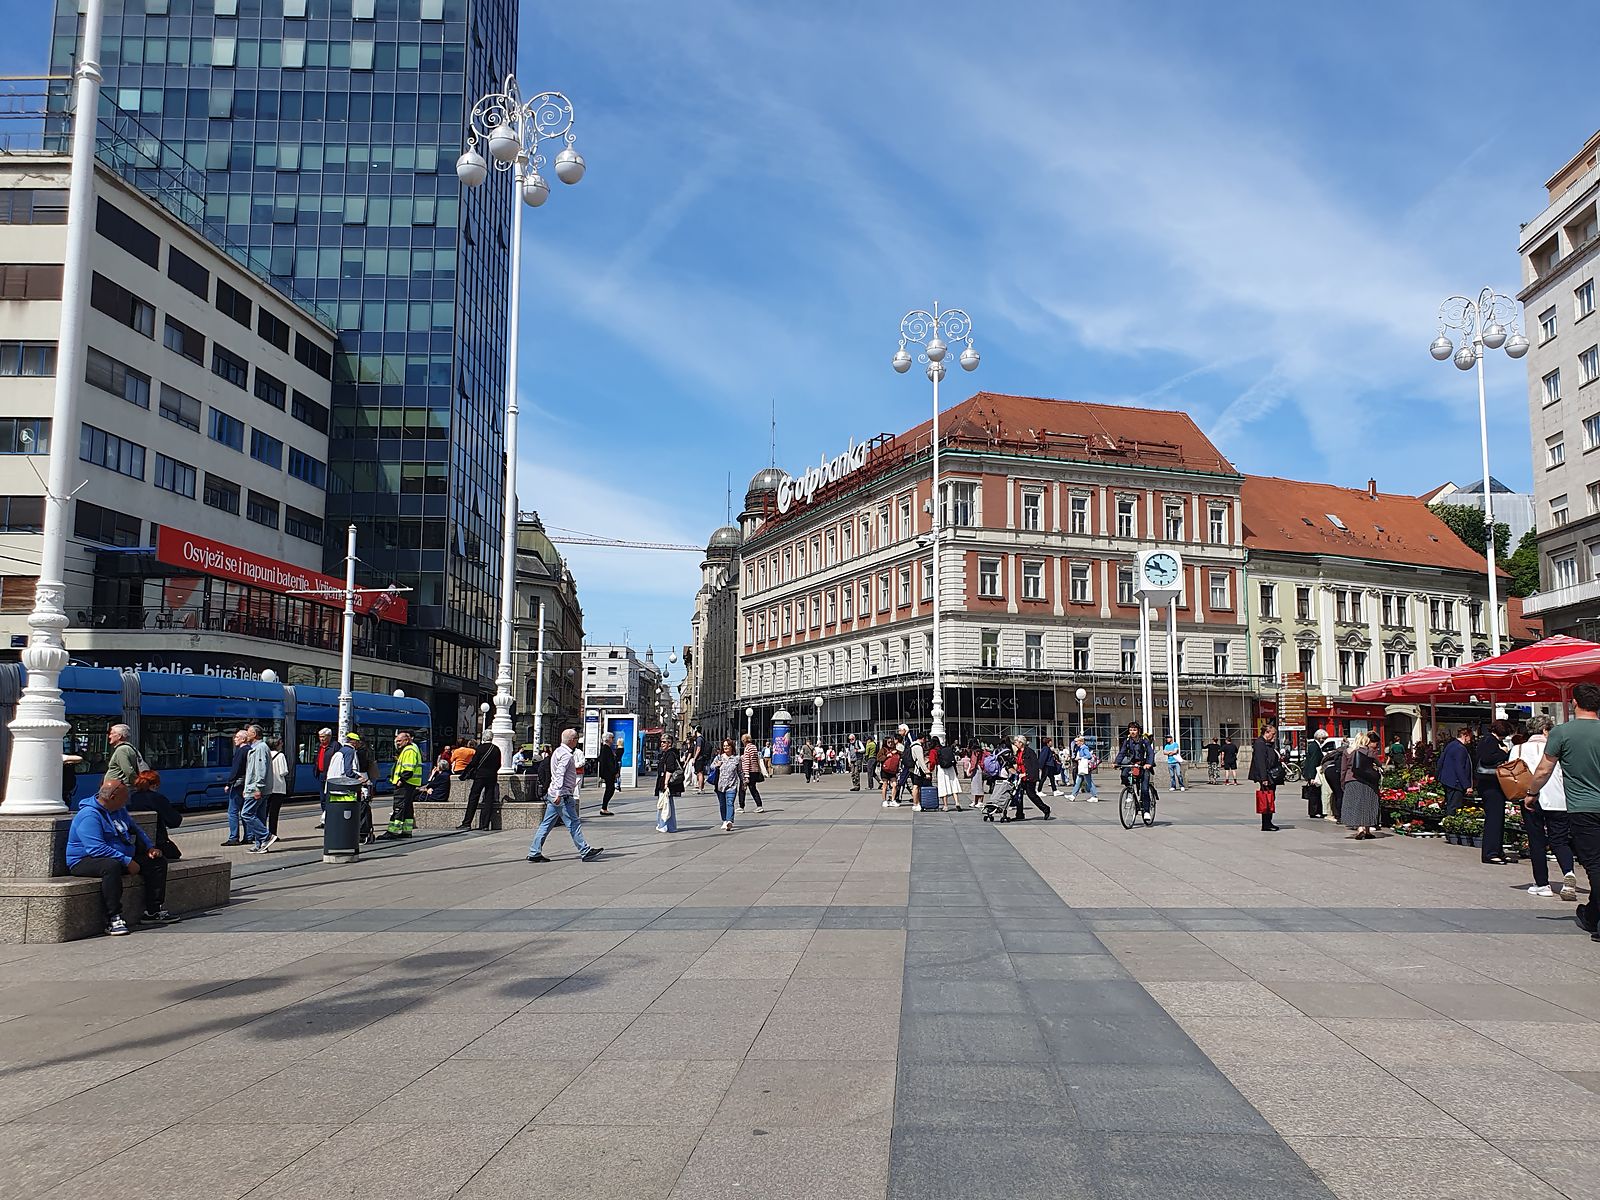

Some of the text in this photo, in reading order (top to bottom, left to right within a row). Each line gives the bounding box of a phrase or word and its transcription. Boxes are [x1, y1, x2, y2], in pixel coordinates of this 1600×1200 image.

[183, 541, 224, 569] Osvježi
[224, 556, 237, 573] se
[238, 557, 242, 574] i
[243, 561, 275, 582] napuni
[1136, 698, 1193, 708] HLDNG
